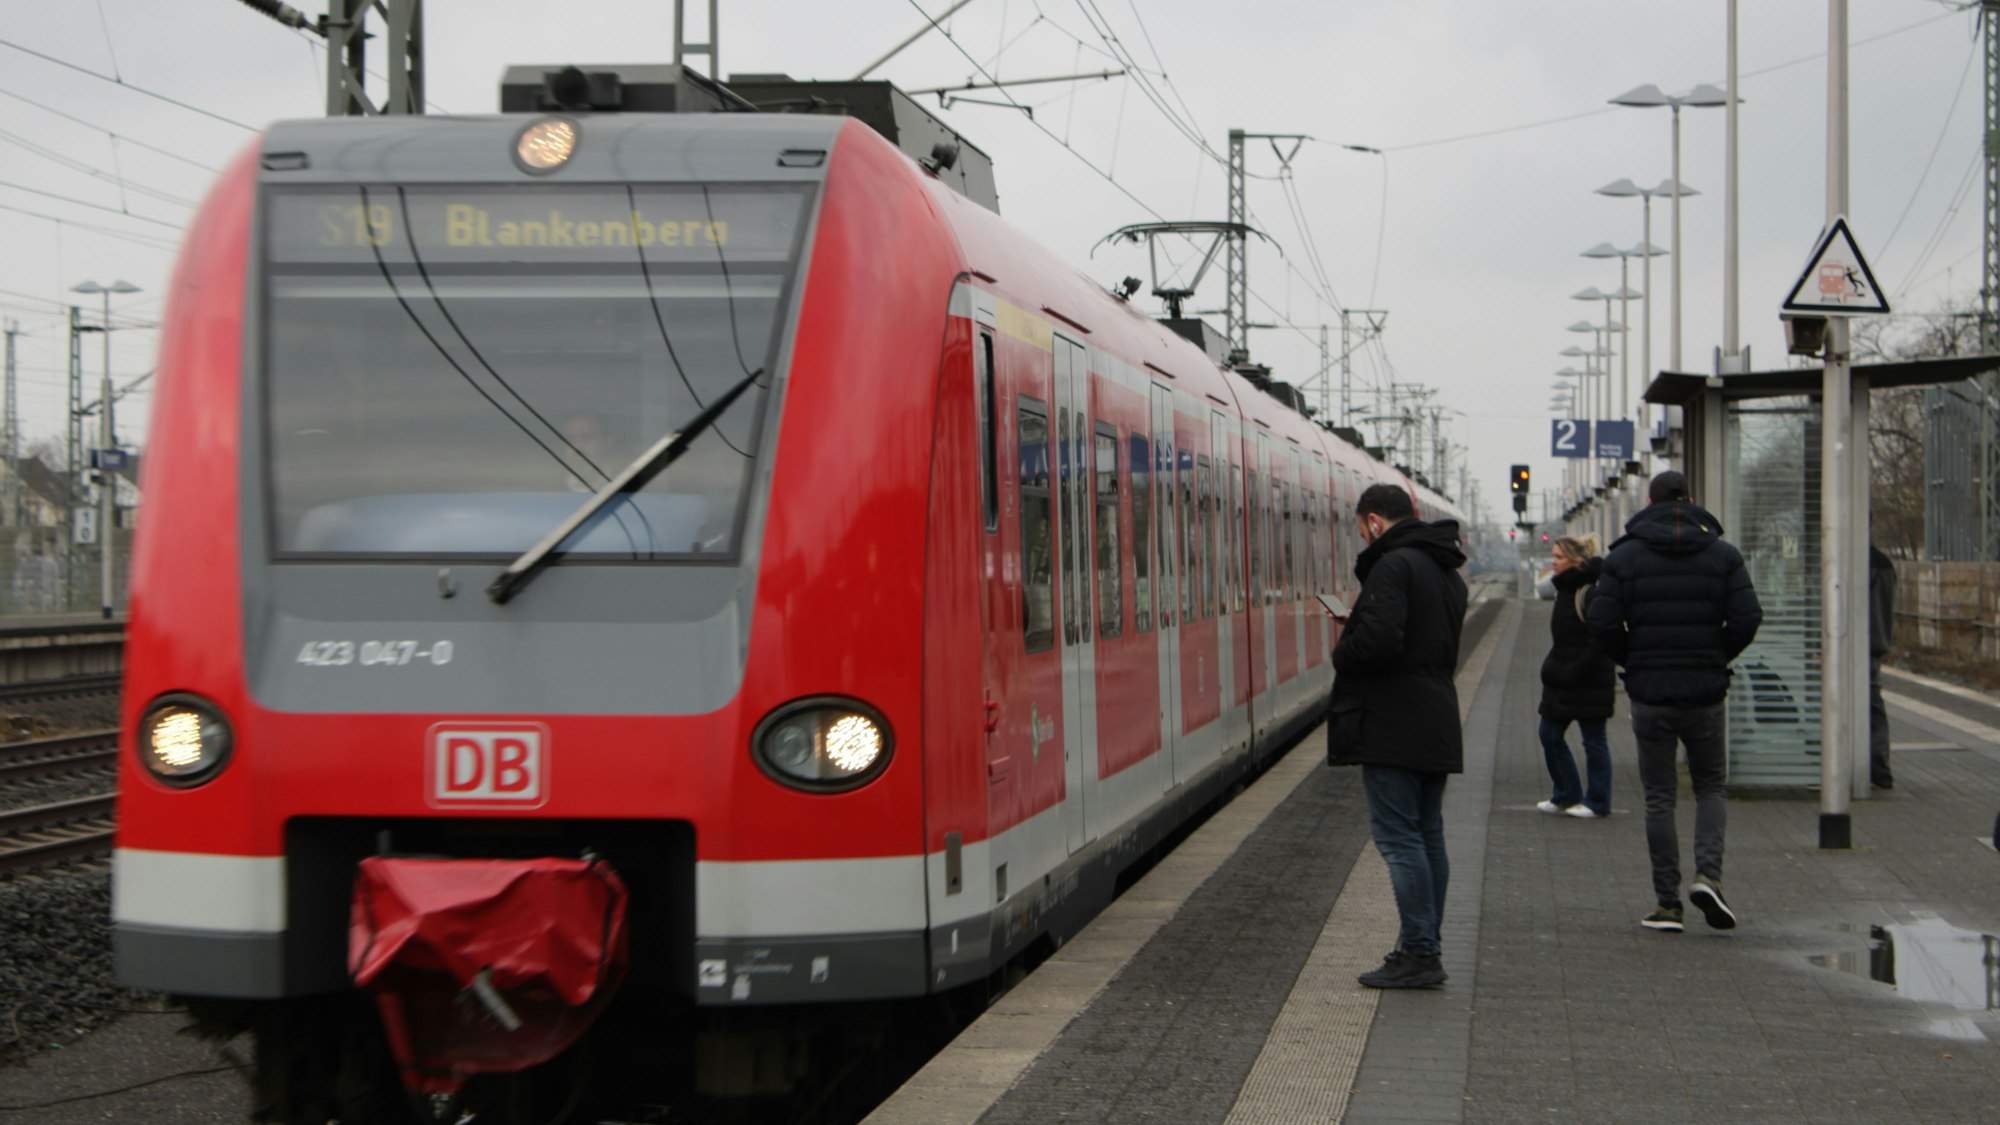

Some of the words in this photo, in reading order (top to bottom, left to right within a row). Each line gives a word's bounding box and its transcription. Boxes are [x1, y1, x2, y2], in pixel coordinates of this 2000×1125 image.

[319, 204, 394, 247] S19
[446, 204, 730, 247] Blankenberg
[1557, 421, 1576, 450] 2
[296, 640, 355, 666] 423
[359, 640, 454, 666] 047-0
[446, 738, 531, 793] DB
